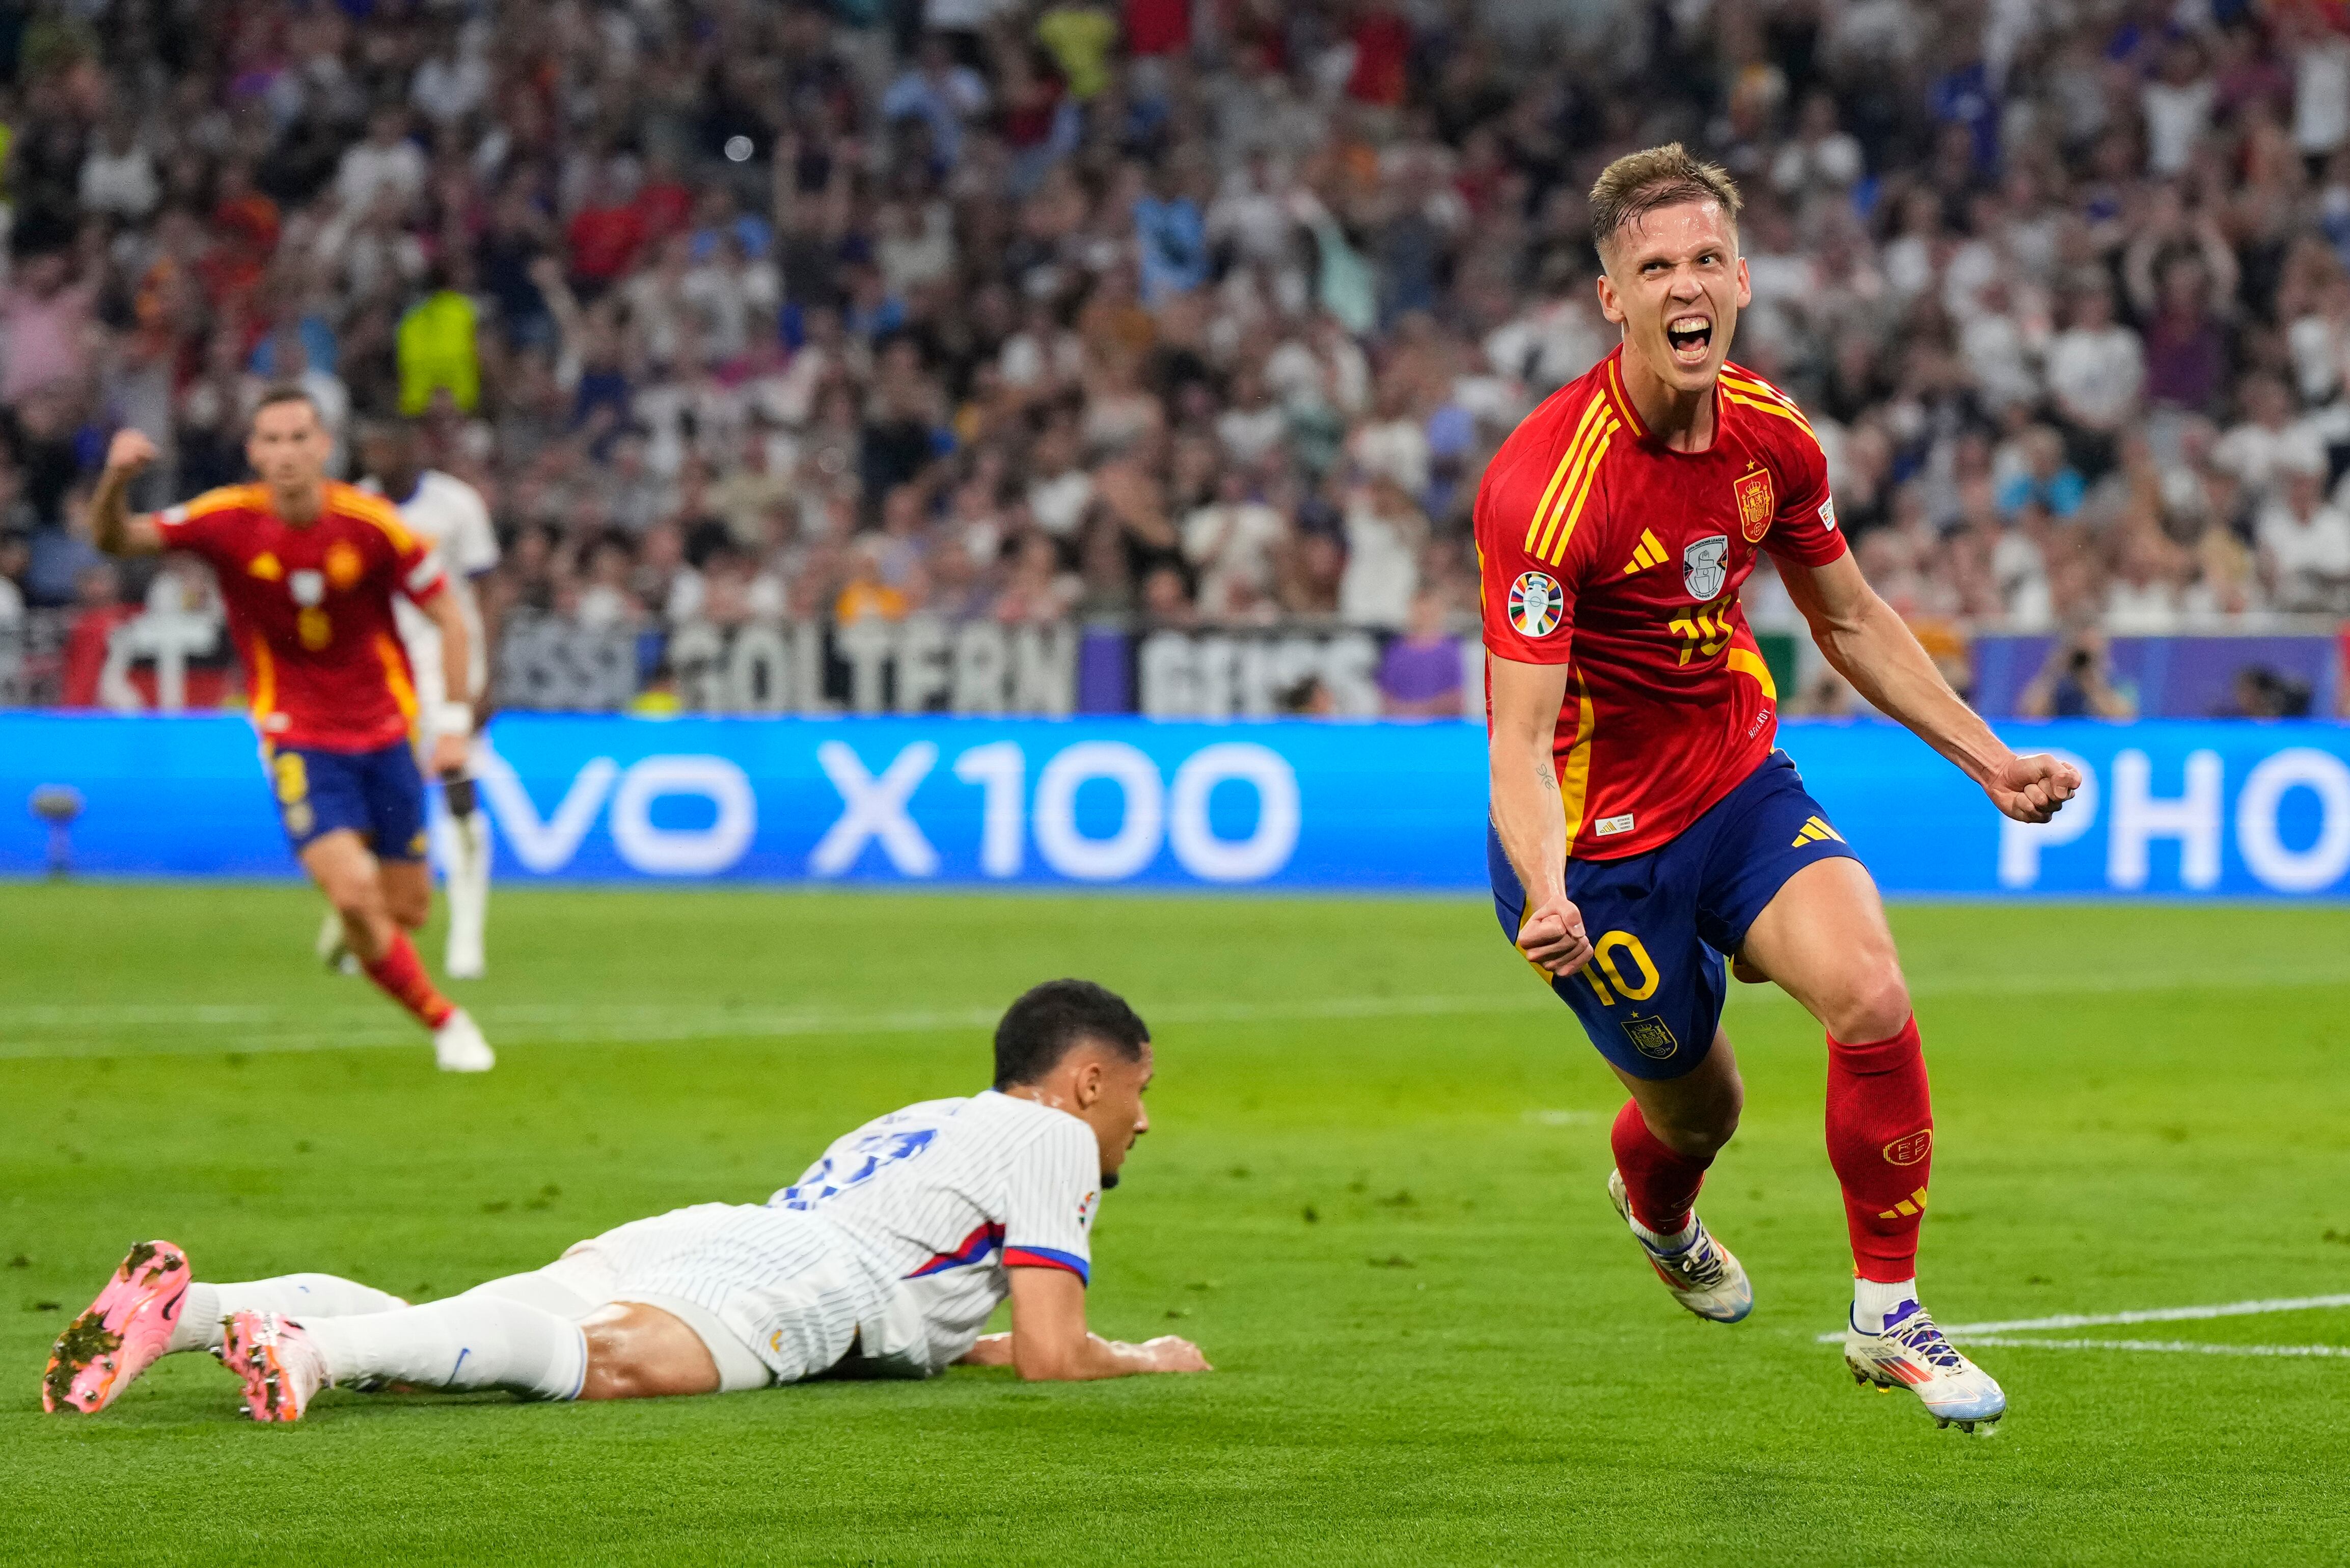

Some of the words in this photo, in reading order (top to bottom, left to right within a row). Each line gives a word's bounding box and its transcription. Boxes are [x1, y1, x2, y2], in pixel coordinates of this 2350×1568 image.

[1668, 594, 1734, 667] 10
[812, 738, 1302, 881] X100
[1998, 746, 2350, 893] PHO
[1580, 930, 1660, 1006] 10
